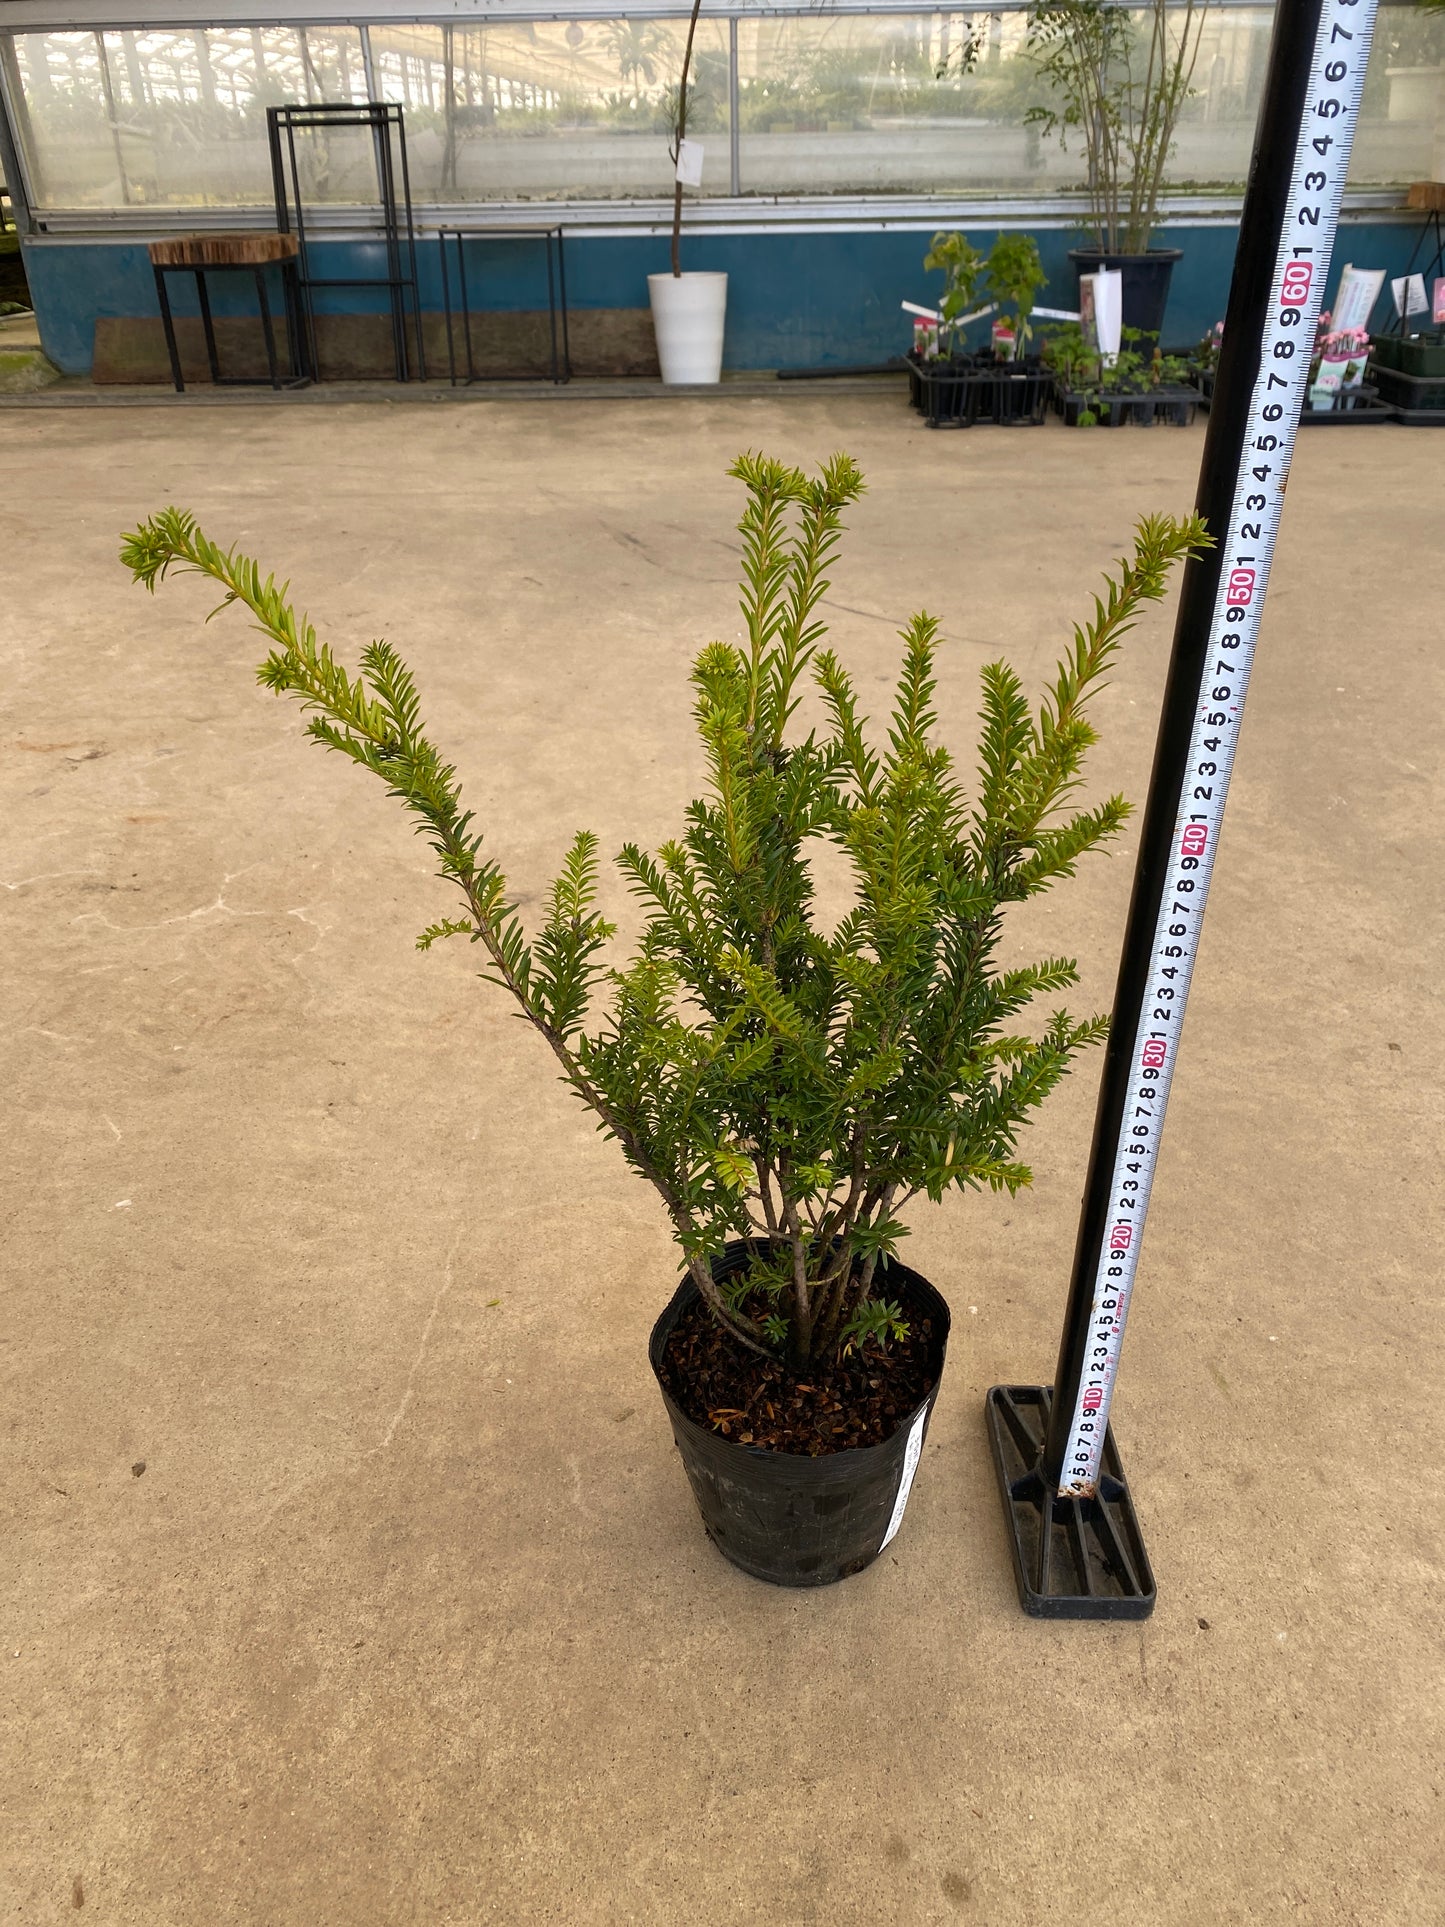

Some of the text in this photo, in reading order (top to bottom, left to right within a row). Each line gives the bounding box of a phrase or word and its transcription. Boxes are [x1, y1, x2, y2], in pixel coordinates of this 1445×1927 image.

[1331, 23, 1353, 43] 7
[1325, 61, 1347, 82] 6
[1318, 99, 1339, 118] 5
[1312, 135, 1333, 155] 4
[1305, 171, 1326, 191] 3
[1298, 207, 1320, 225] 2
[1293, 247, 1313, 258] 1
[1283, 267, 1310, 300] 60
[1280, 308, 1301, 326] 9
[1274, 341, 1295, 359] 8
[1267, 373, 1288, 390] 7
[1262, 404, 1283, 421] 6
[1256, 435, 1277, 451] 5
[1252, 464, 1271, 482] 4
[1246, 494, 1266, 511] 3
[1241, 523, 1261, 539] 2
[1236, 557, 1255, 566] 1
[1229, 573, 1253, 600] 50
[1226, 607, 1245, 622] 9
[1221, 634, 1240, 649] 8
[1216, 660, 1235, 675] 7
[1212, 686, 1231, 701] 6
[1207, 712, 1226, 726] 5
[1203, 737, 1221, 752] 4
[1198, 762, 1216, 776] 3
[1194, 786, 1213, 800] 2
[1190, 814, 1207, 822] 1
[1184, 827, 1205, 852] 40
[1181, 857, 1199, 870] 9
[1176, 880, 1195, 892] 8
[1172, 901, 1190, 914] 7
[1169, 923, 1186, 936] 6
[1165, 945, 1182, 958] 5
[1161, 967, 1179, 979] 4
[1157, 988, 1174, 1000] 3
[1153, 1008, 1171, 1021] 2
[1144, 1043, 1165, 1064] 30
[1142, 1068, 1159, 1079] 9
[1139, 1087, 1156, 1099] 8
[1135, 1106, 1152, 1117] 7
[1132, 1125, 1149, 1136] 6
[1129, 1144, 1145, 1155] 5
[1126, 1162, 1142, 1173] 4
[1122, 1180, 1139, 1191] 3
[1119, 1198, 1135, 1209] 2
[1112, 1227, 1130, 1246] 20
[1110, 1249, 1126, 1260] 9
[1107, 1266, 1122, 1276] 8
[1104, 1283, 1119, 1293] 7
[1102, 1299, 1116, 1309] 6
[1099, 1315, 1114, 1325] 5
[1096, 1331, 1111, 1341] 4
[1093, 1347, 1108, 1356] 3
[1090, 1363, 1105, 1372] 2
[1085, 1389, 1101, 1406] 10
[1082, 1407, 1097, 1417] 9
[1080, 1423, 1094, 1432] 8
[1077, 1438, 1091, 1447] 7
[1075, 1453, 1089, 1462] 6
[1072, 1467, 1086, 1477] 5
